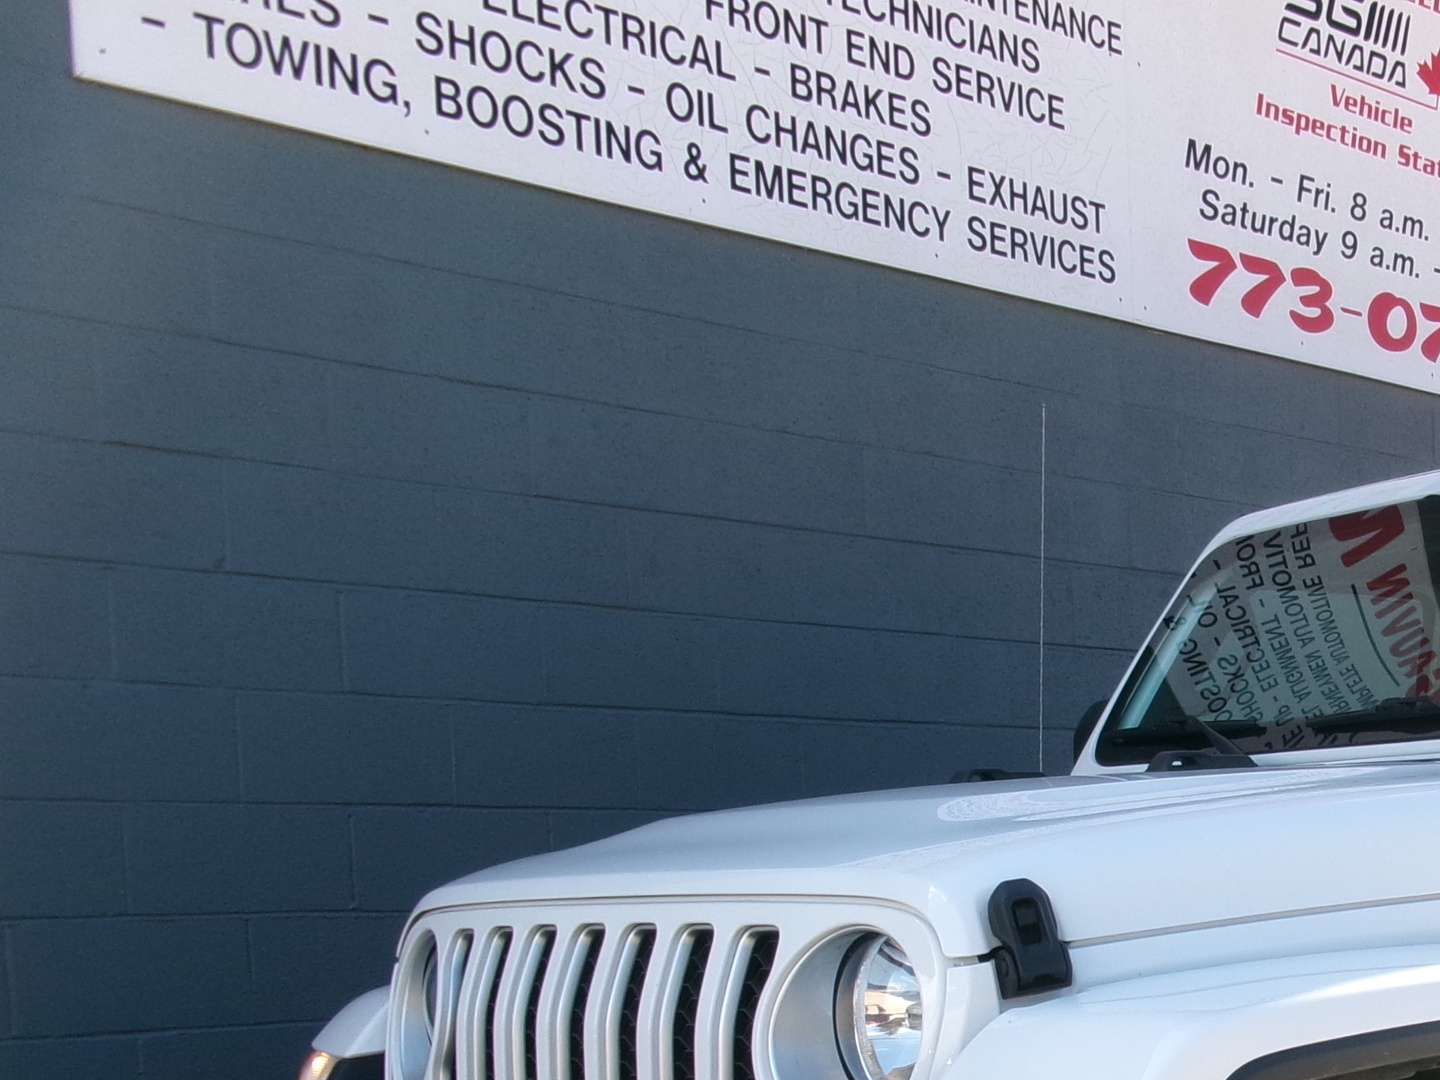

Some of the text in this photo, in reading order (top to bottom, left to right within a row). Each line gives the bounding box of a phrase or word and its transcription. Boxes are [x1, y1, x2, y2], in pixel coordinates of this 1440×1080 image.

[845, 27, 916, 81] END
[931, 57, 1066, 131] SERVICE
[1278, 16, 1407, 89] CANADA
[415, 11, 607, 100] SHOCKS
[665, 82, 729, 134] OIL
[745, 104, 920, 185] CHANGES
[967, 166, 1106, 234] EXHAUST
[789, 62, 932, 138] BRAKES
[1256, 92, 1387, 160] Inspection
[1330, 83, 1413, 134] Vehicle
[192, 12, 411, 118] TOWING,
[434, 75, 663, 173] BOOSTING
[683, 142, 709, 185] &
[728, 153, 951, 242] EMERGENCY
[967, 216, 1116, 284] SERVICES
[1184, 137, 1254, 189] Mon.
[1296, 173, 1336, 214] Fri.
[1349, 191, 1368, 222] 8
[1379, 208, 1429, 242] a.m.
[1199, 188, 1329, 256] Saturday
[1340, 230, 1358, 260] 9
[1369, 246, 1420, 279] a.m.
